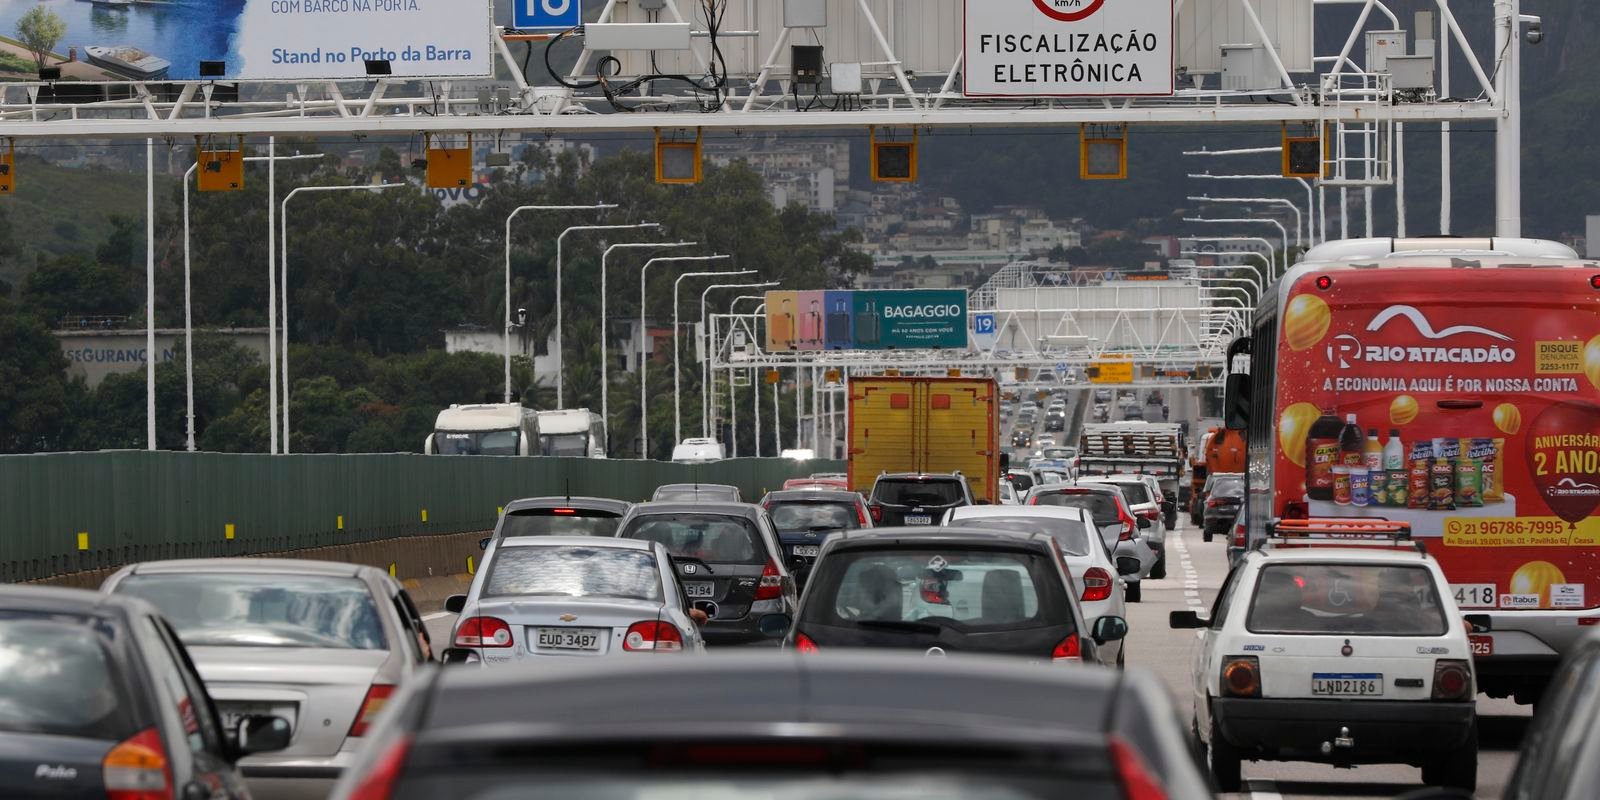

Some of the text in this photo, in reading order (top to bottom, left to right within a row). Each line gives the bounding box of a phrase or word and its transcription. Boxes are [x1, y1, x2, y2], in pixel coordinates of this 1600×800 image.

[271, 0, 421, 13] COM BARCO NA PORTA.
[980, 29, 1157, 54] FISCALIZAÇÃO
[271, 44, 472, 64] Stand no Porto da Barra
[994, 57, 1142, 83] ELETRÔNICA
[884, 304, 960, 318] BAGAGGIO
[977, 318, 992, 332] 19
[67, 348, 157, 365] SEGURANÇ
[1365, 344, 1516, 363] RIO ATACADÃO
[1540, 343, 1579, 353] DISQUE
[1540, 363, 1580, 371] 2253-1177
[1323, 374, 1578, 392] A ECONOMIA AQUI É POR NOSSA CONTA
[1535, 432, 1600, 449] ANIVERSÁR
[1534, 452, 1548, 476] 2
[1464, 520, 1563, 535] 21 96786-7995
[1512, 596, 1537, 604] Itabus
